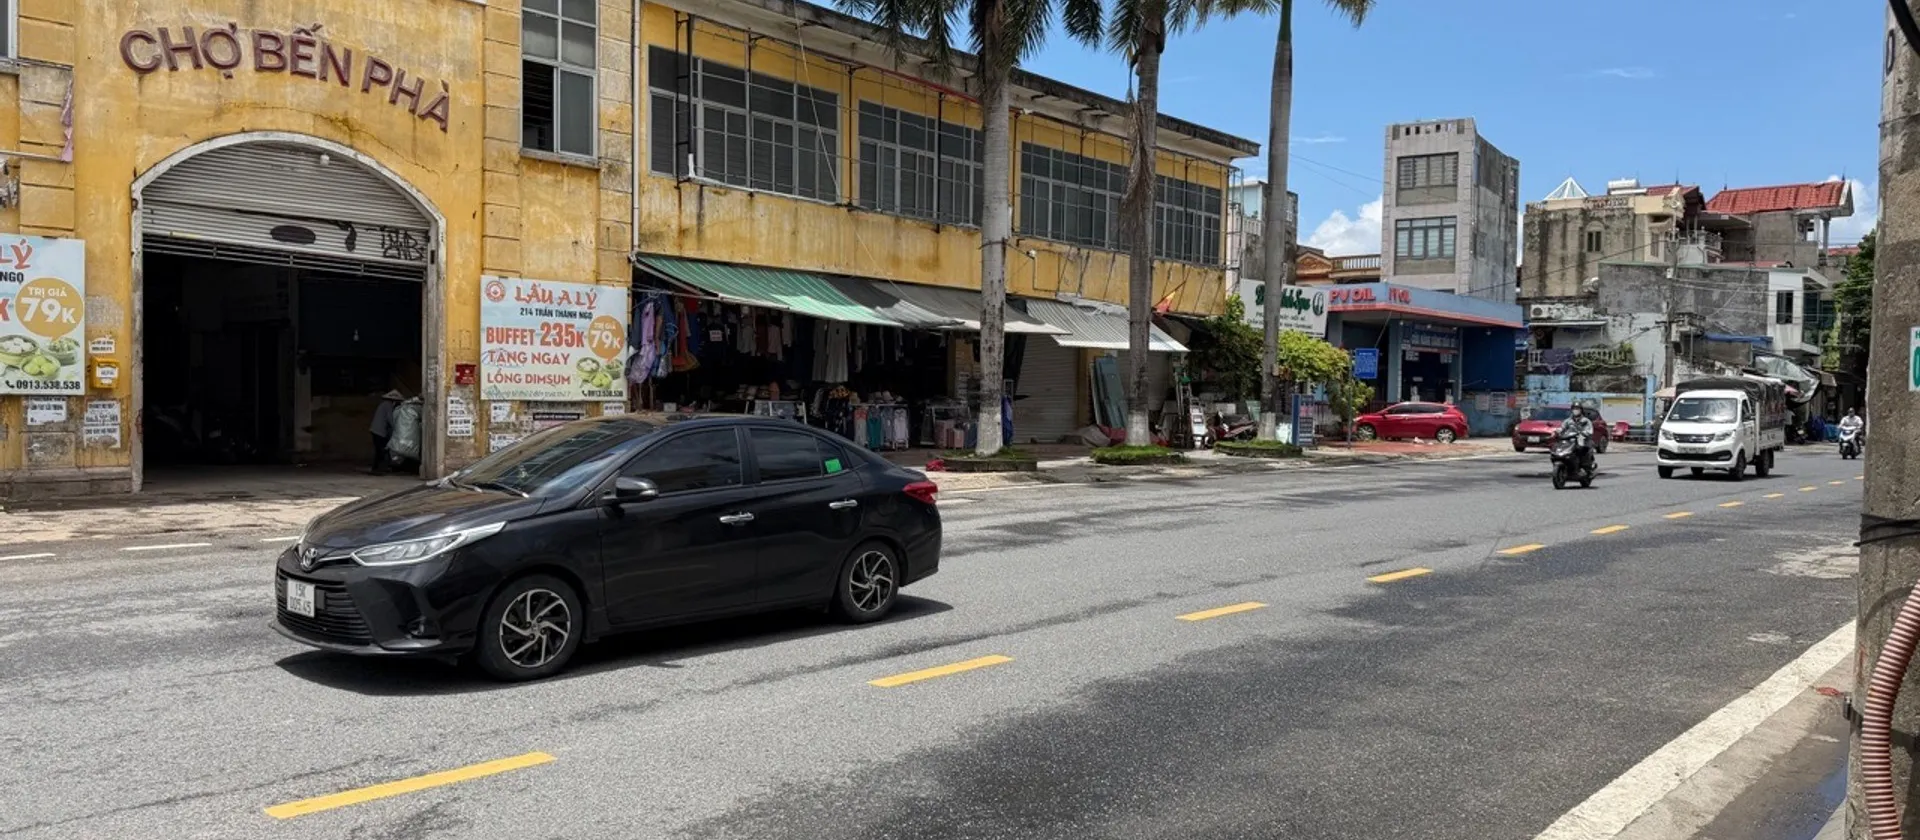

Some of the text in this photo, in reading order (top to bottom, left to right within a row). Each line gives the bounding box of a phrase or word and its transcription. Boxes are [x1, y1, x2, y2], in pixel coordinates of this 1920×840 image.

[119, 21, 451, 133] CHỢ BẾN PHÀ
[28, 287, 45, 298] TRỊ
[557, 289, 573, 306] A
[575, 287, 598, 309] LÝ
[1330, 289, 1349, 303] PV
[1352, 287, 1376, 303] OIL
[21, 297, 76, 324] 79K
[519, 307, 533, 317] 214
[486, 321, 584, 348] BUFFET 235K
[591, 330, 622, 349] 79K
[531, 352, 570, 365] NGAY
[16, 381, 81, 390] 0913.538.538
[525, 374, 570, 385] DIMSUM
